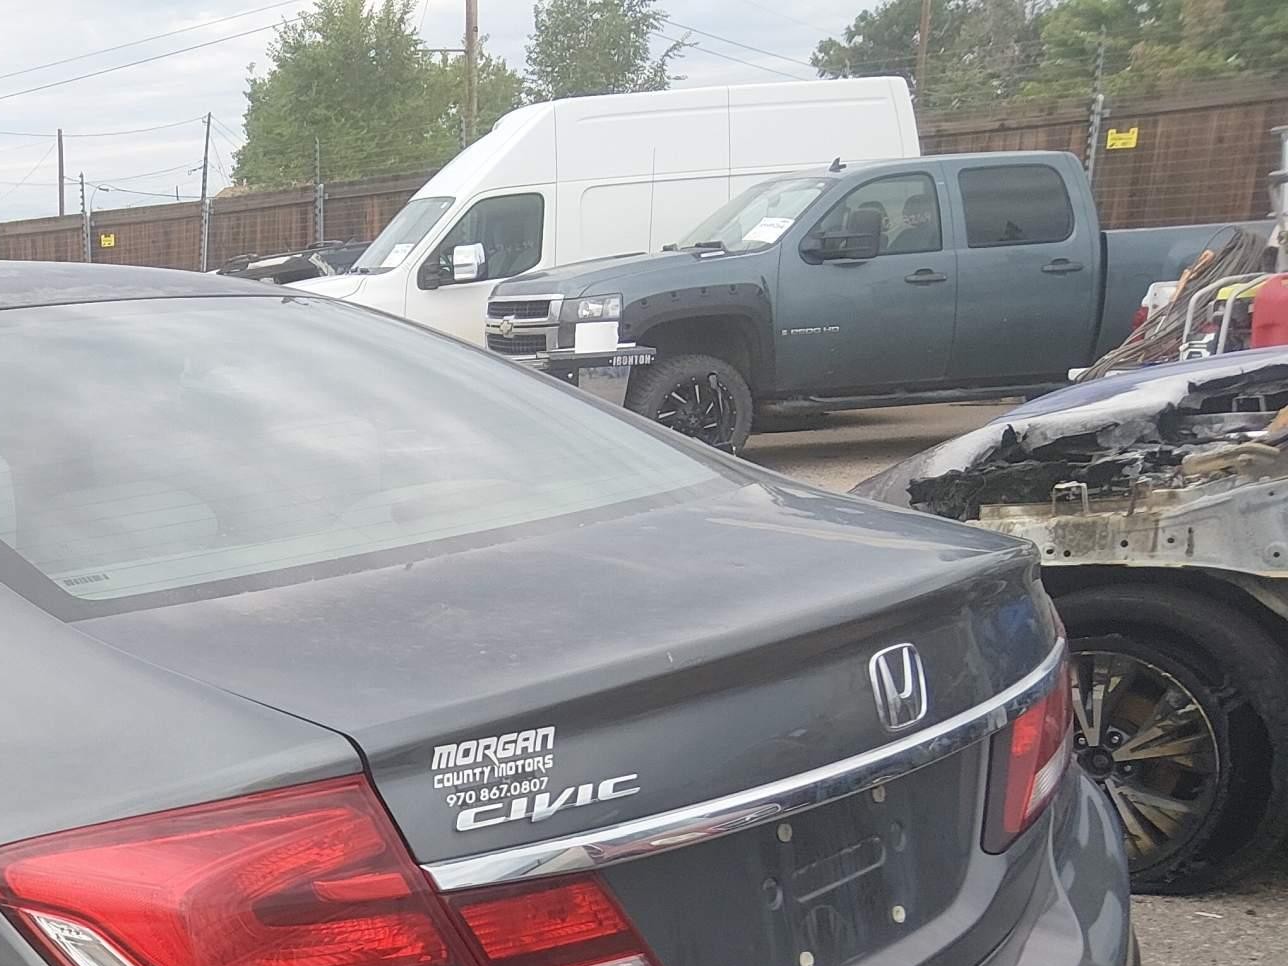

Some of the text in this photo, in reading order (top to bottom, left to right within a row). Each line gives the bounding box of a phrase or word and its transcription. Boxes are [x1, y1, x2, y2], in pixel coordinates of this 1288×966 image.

[431, 726, 556, 770] MORGAN
[433, 753, 554, 789] COUNTY MOTORS
[446, 776, 549, 808] 970 867.0807
[456, 773, 641, 832] CIVIC
